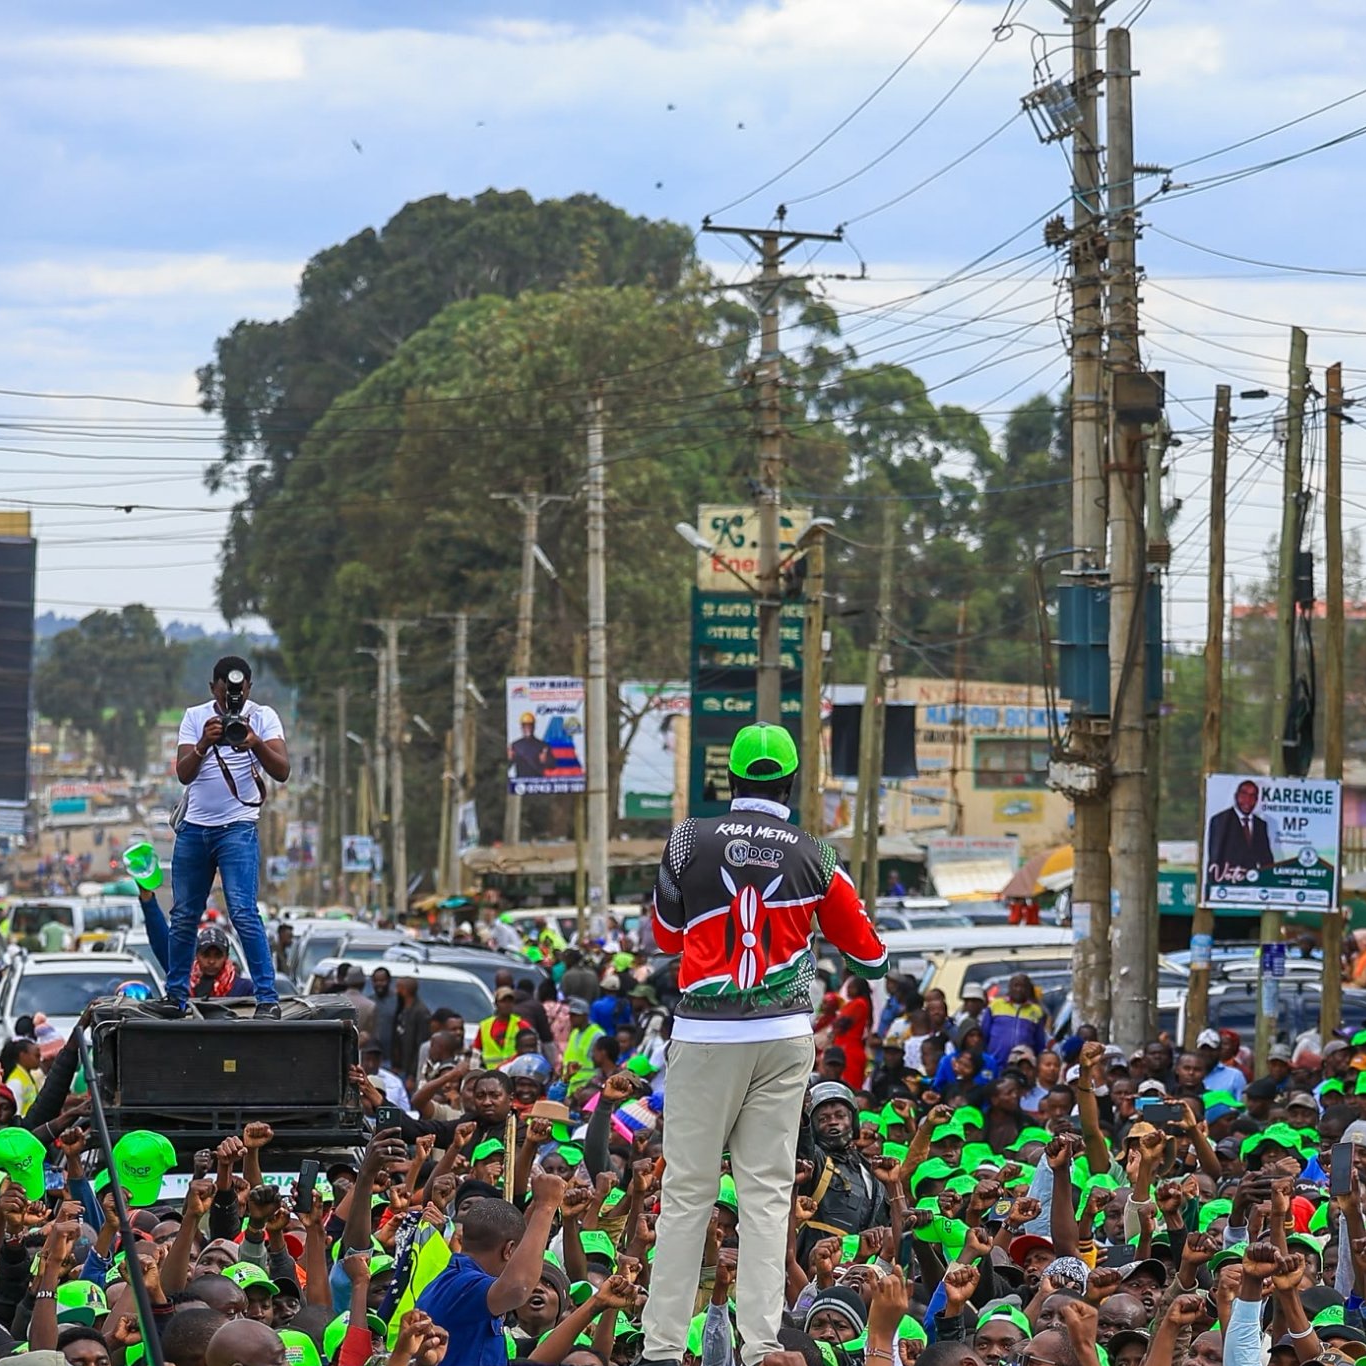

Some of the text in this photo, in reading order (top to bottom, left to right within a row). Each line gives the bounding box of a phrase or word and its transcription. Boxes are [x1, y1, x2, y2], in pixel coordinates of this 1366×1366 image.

[723, 697, 753, 712] Car
[1261, 787, 1334, 805] KARENGE
[1262, 804, 1332, 815] ONESMUS MUNGAI
[1283, 817, 1309, 831] MP
[715, 823, 799, 844] KABA METHU
[748, 845, 784, 862] DCP
[1208, 861, 1247, 884] Vote
[15, 1155, 33, 1169] DCP
